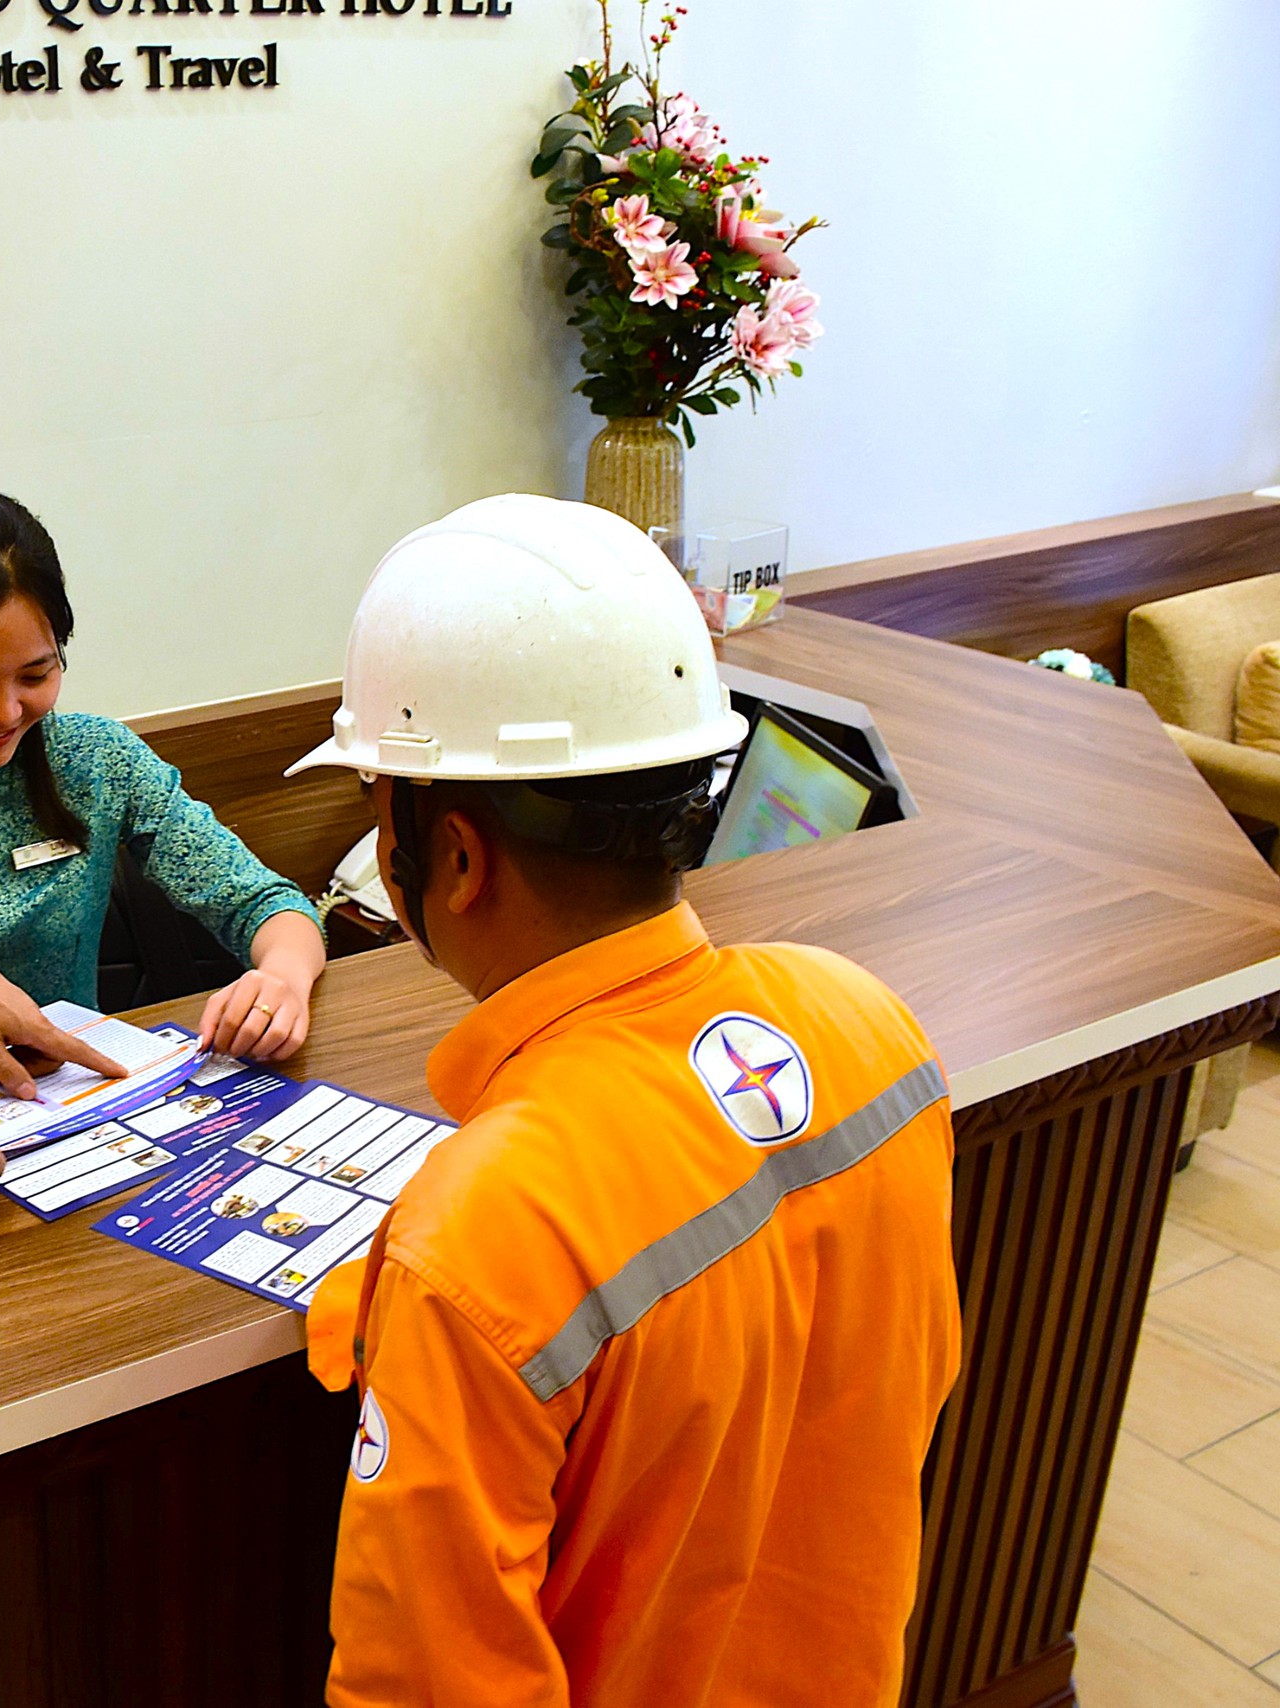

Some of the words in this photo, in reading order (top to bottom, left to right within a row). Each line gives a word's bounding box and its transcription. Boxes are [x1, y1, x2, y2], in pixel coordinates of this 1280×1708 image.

[79, 46, 124, 94] &
[136, 43, 280, 91] Travel
[733, 569, 752, 595] TIP
[755, 562, 780, 590] BOX
